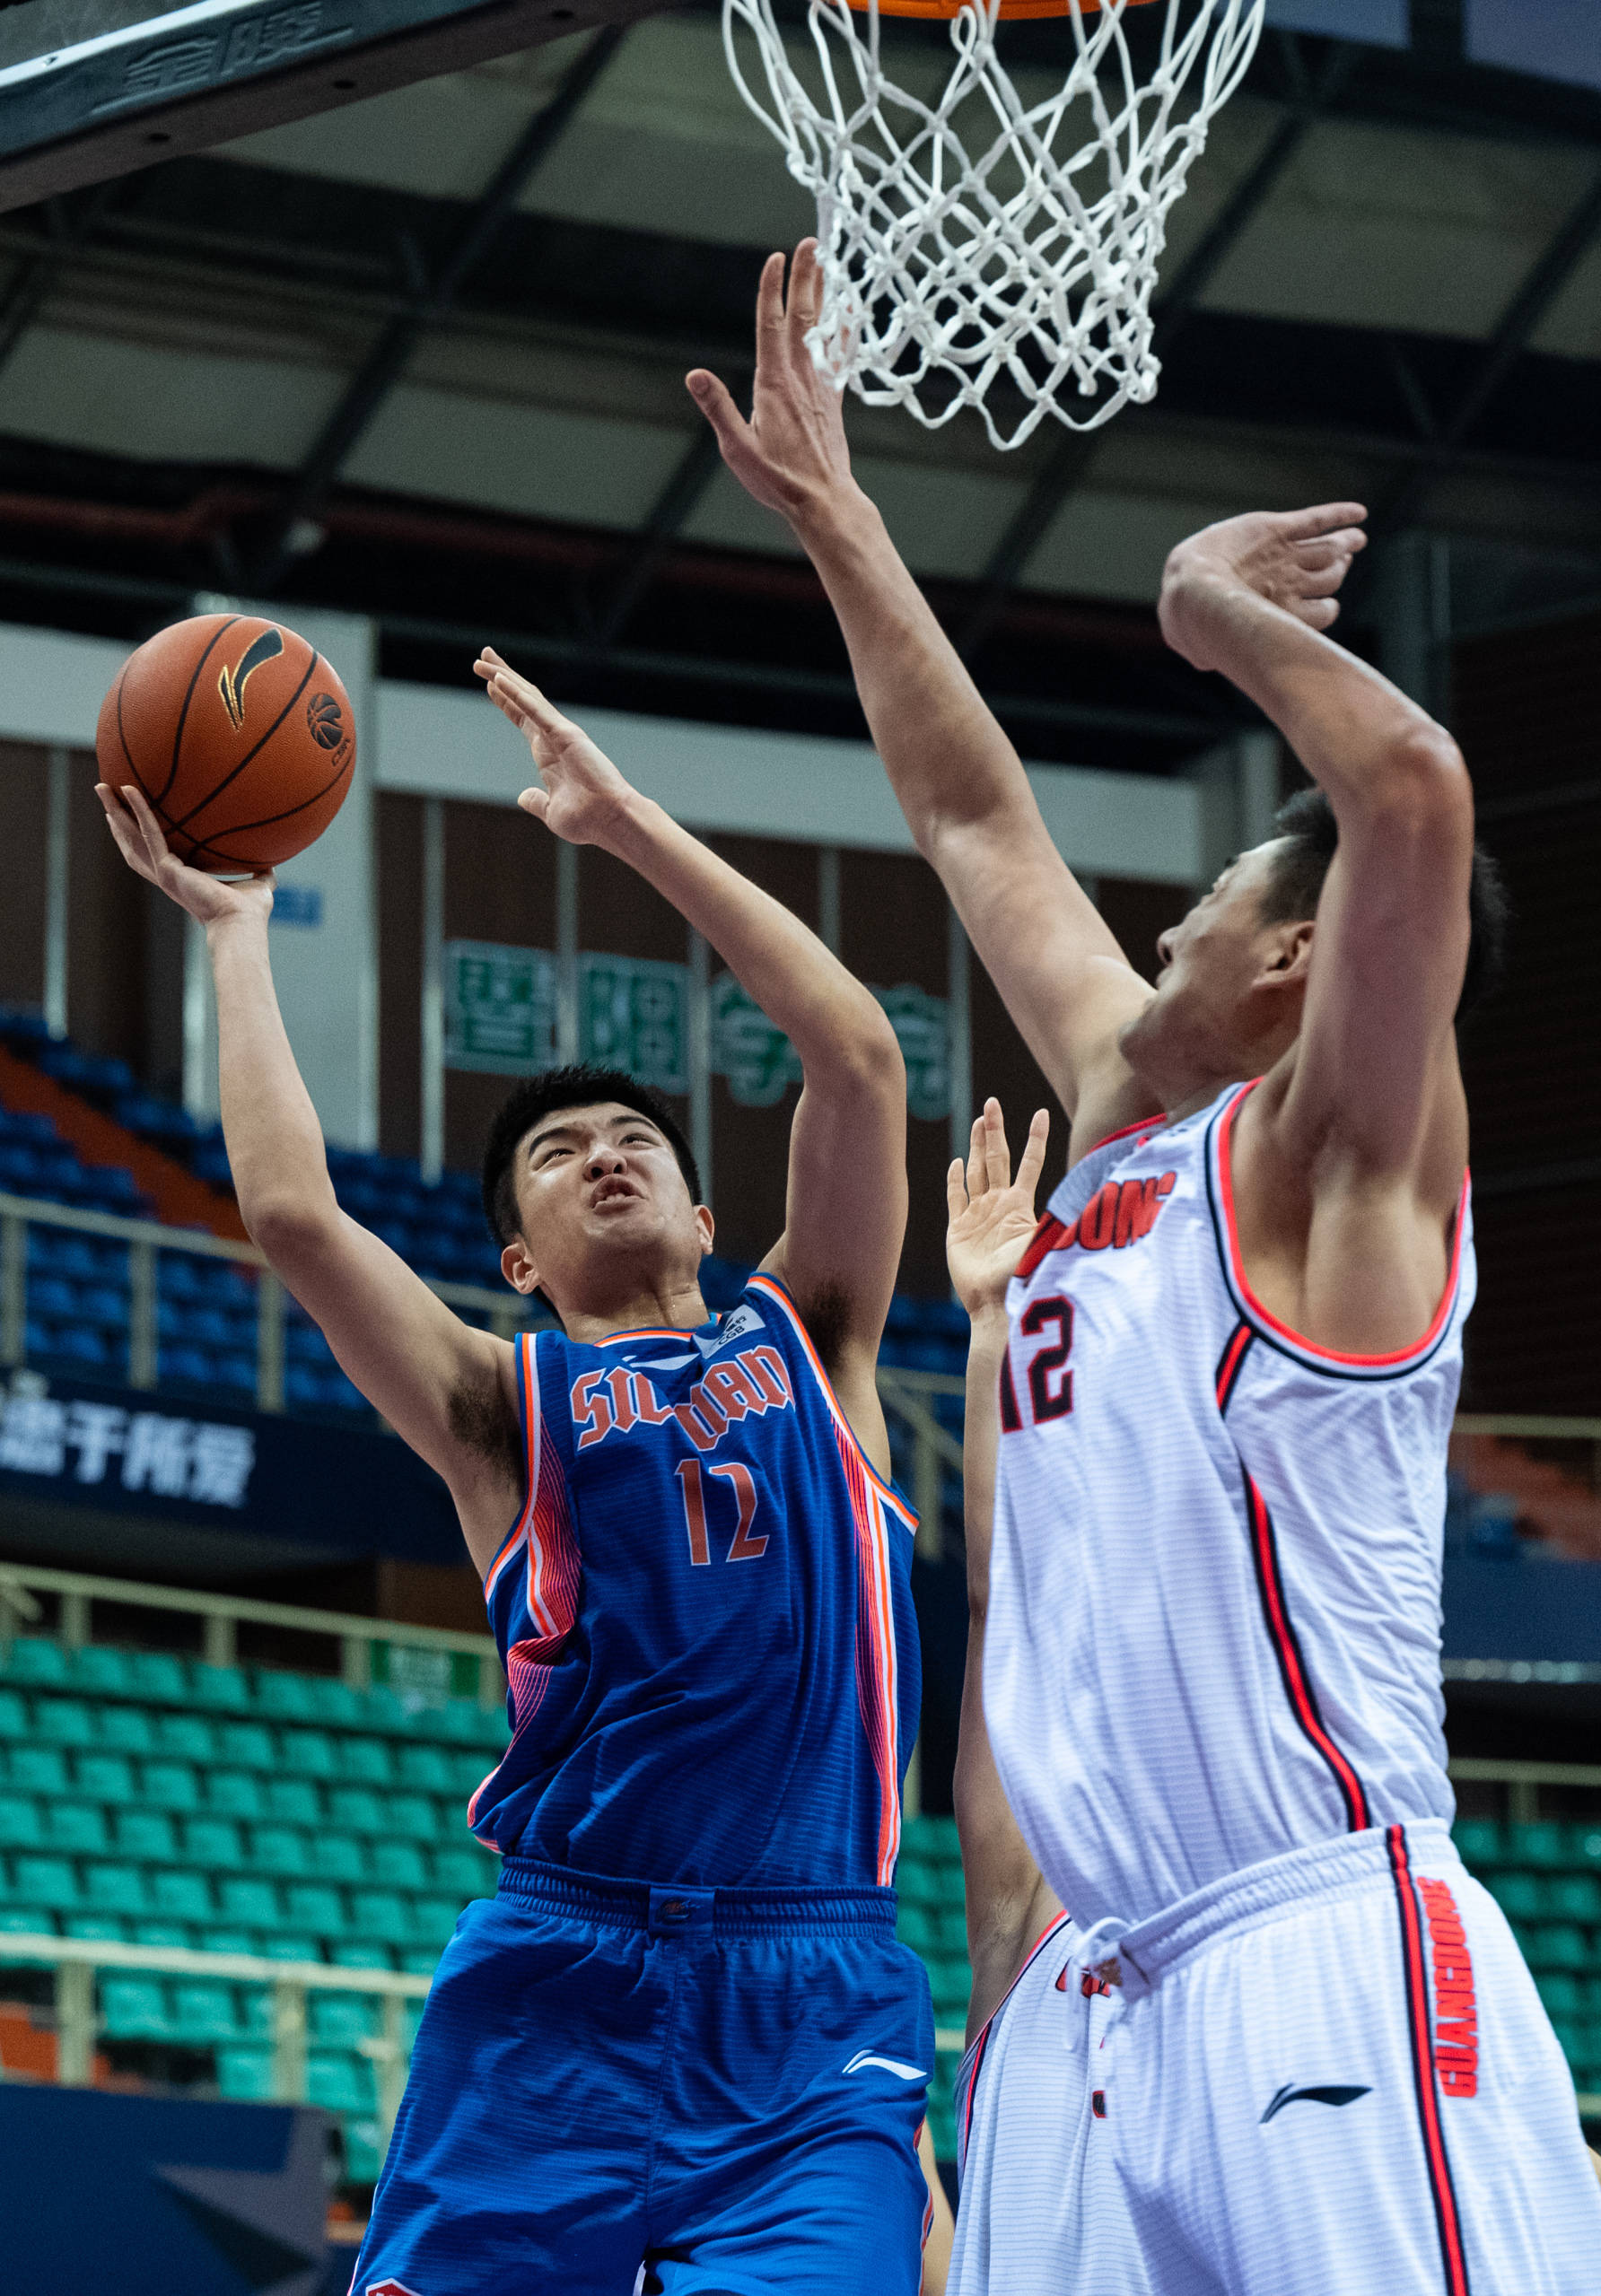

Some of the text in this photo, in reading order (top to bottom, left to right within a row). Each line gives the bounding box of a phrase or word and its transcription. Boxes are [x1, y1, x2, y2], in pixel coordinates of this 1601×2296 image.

[718, 1325, 745, 1345] CGB
[999, 1296, 1074, 1434] 12
[570, 1345, 797, 1452] SICUAN
[675, 1458, 769, 1566] 12
[1416, 1875, 1479, 2099] GUANGDONG
